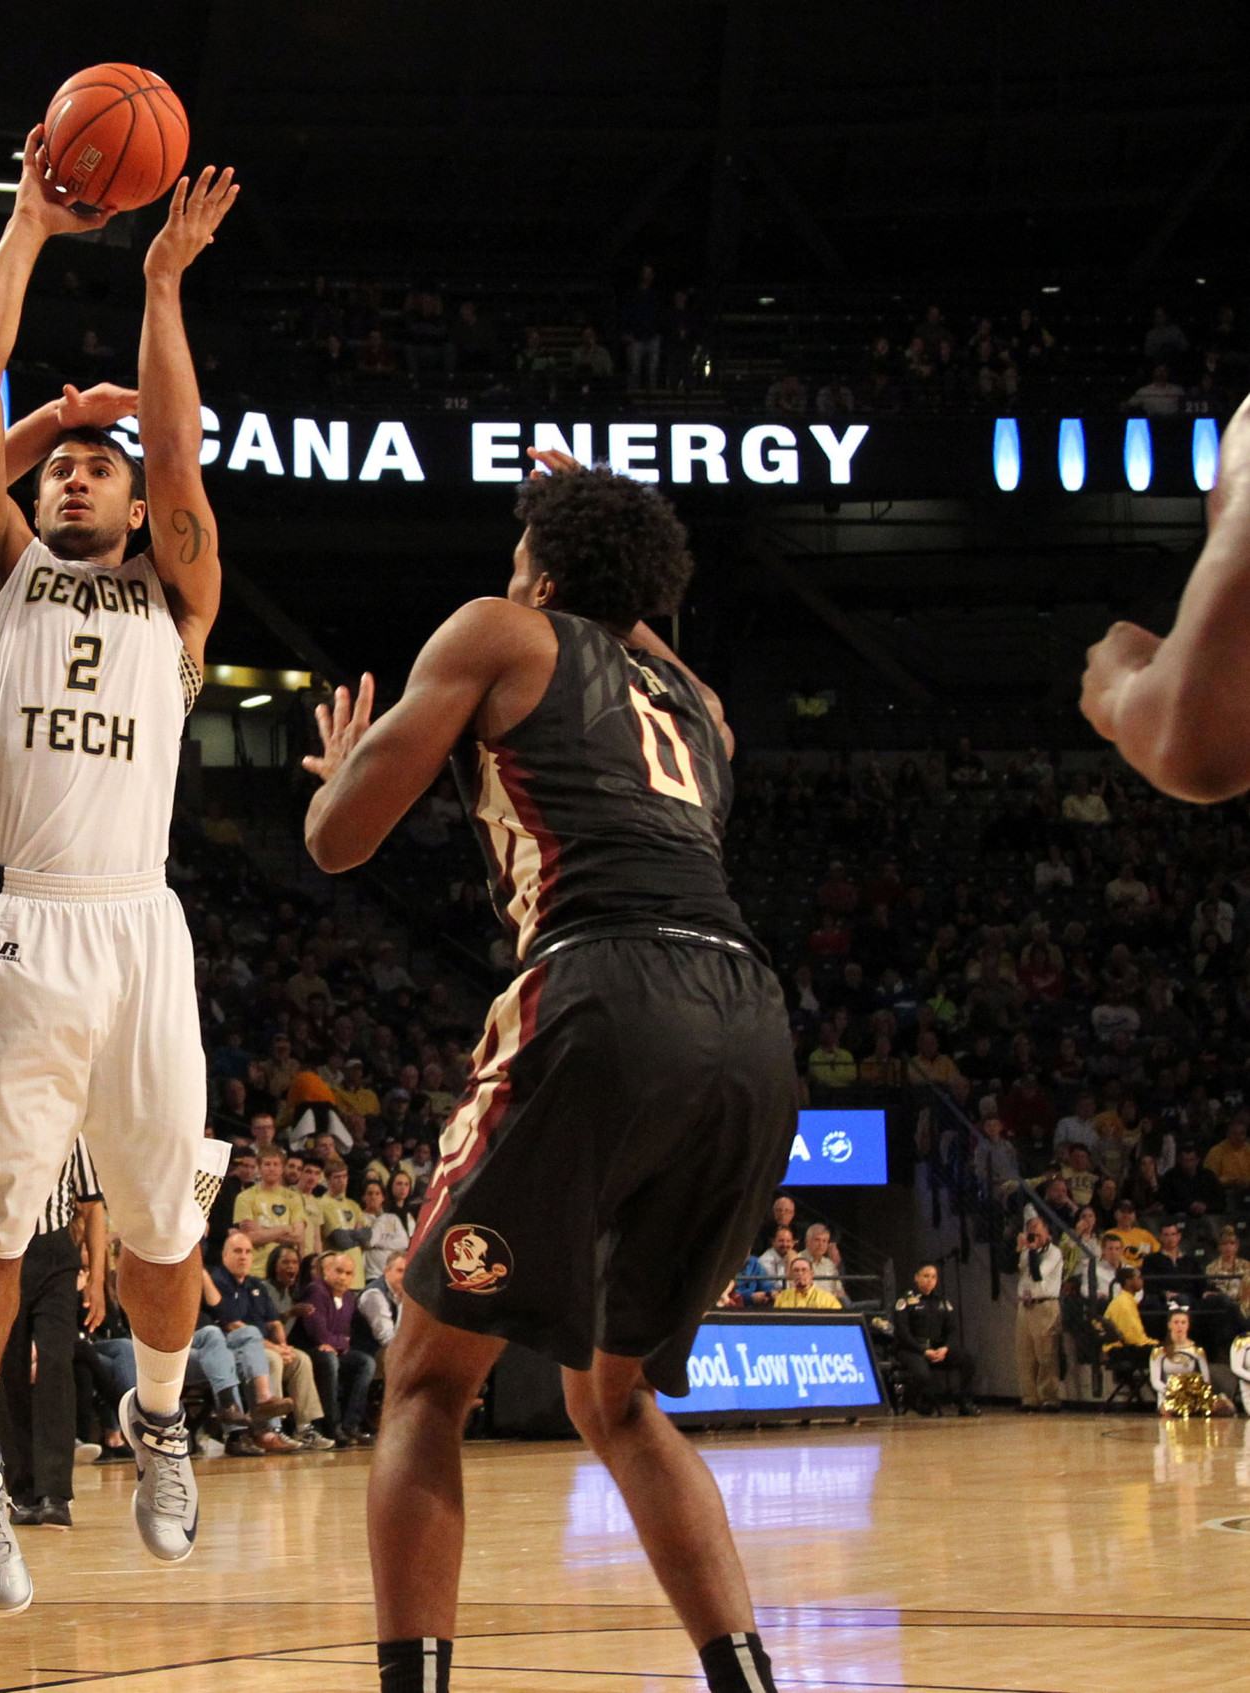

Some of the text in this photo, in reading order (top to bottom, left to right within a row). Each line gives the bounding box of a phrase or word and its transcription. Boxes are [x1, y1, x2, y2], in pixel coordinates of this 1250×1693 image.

[445, 397, 468, 409] 212
[471, 422, 870, 484] ENERGY
[65, 633, 104, 694] 2
[20, 706, 136, 764] TECH
[628, 682, 705, 808] 0
[789, 1133, 811, 1162] A
[735, 1343, 789, 1387] Low
[790, 1342, 865, 1398] prices.
